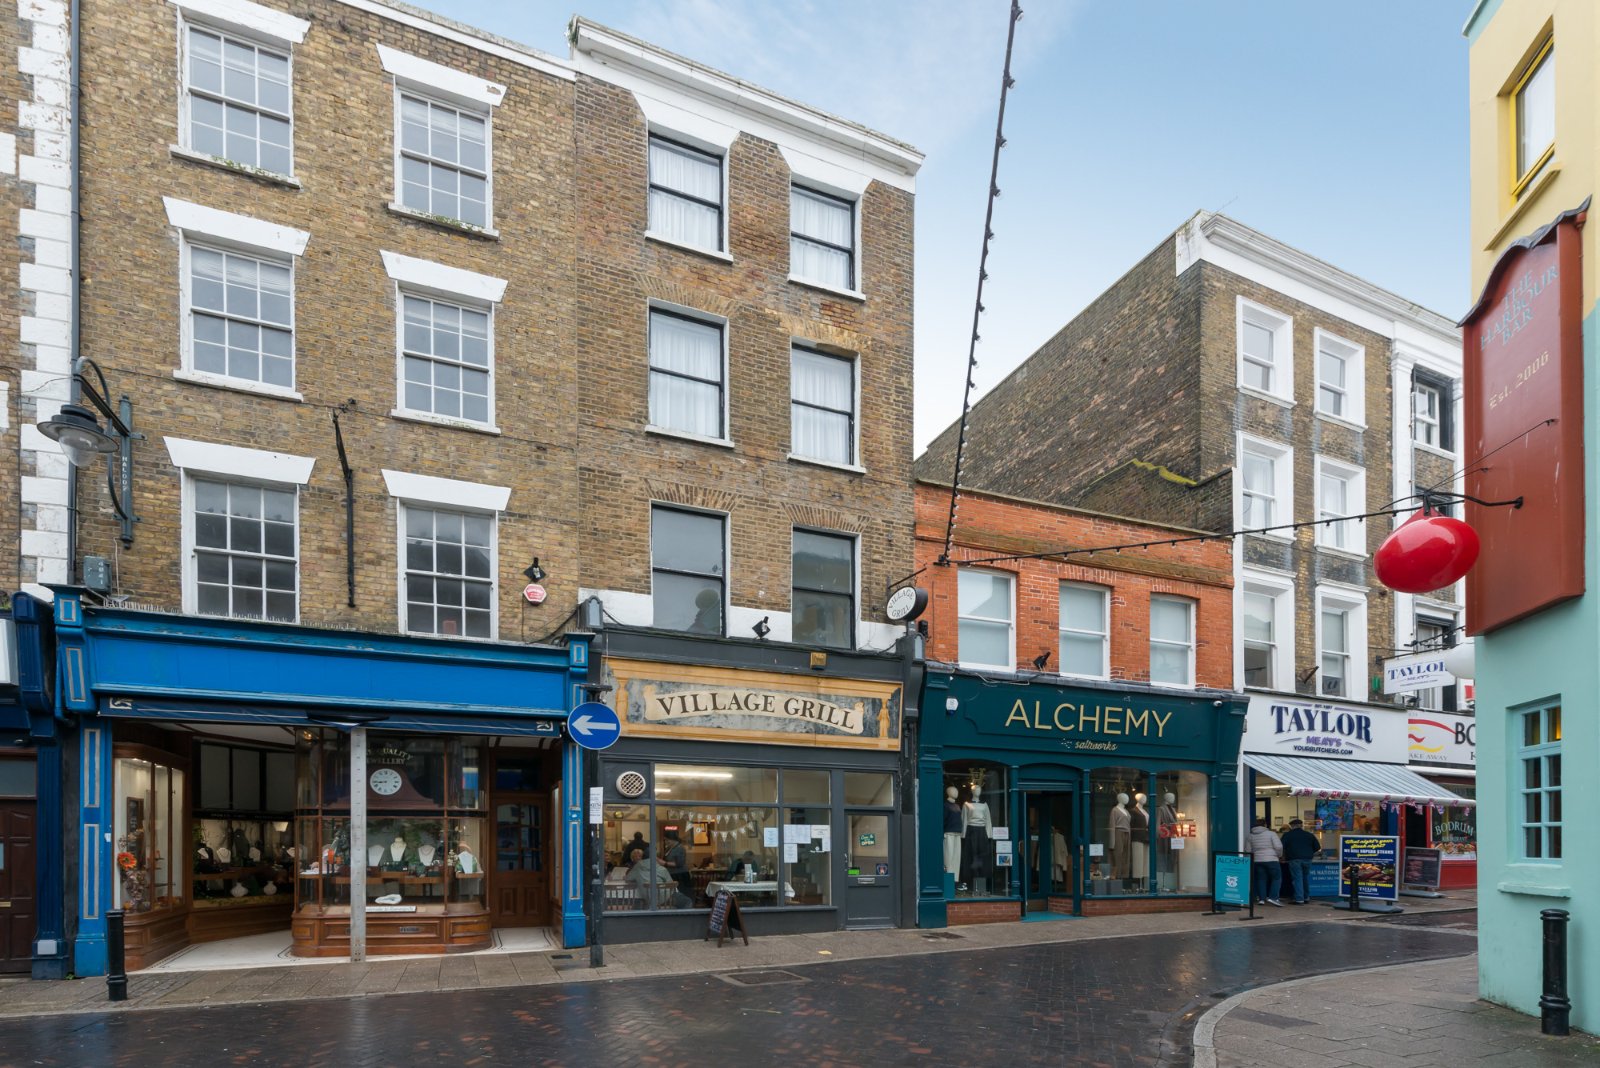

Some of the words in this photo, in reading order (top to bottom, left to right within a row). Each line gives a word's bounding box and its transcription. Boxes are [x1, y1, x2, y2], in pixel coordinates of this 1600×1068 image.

[1480, 265, 1559, 350] HARBOUR
[1503, 270, 1533, 310] THE
[1502, 307, 1534, 346] BAR
[1489, 384, 1513, 410] Est.
[1516, 351, 1550, 389] 2006
[888, 589, 915, 609] VILLAGE
[891, 604, 912, 618] GRILL
[656, 691, 775, 716] VILLAGE
[783, 697, 855, 730] GRILL
[1004, 698, 1173, 738] ALCHEMY
[1270, 705, 1373, 744] TAYLOR
[1293, 745, 1353, 755] YOURBUTCHERS.COM
[1159, 823, 1196, 838] SALE
[1434, 821, 1474, 836] BODRUM
